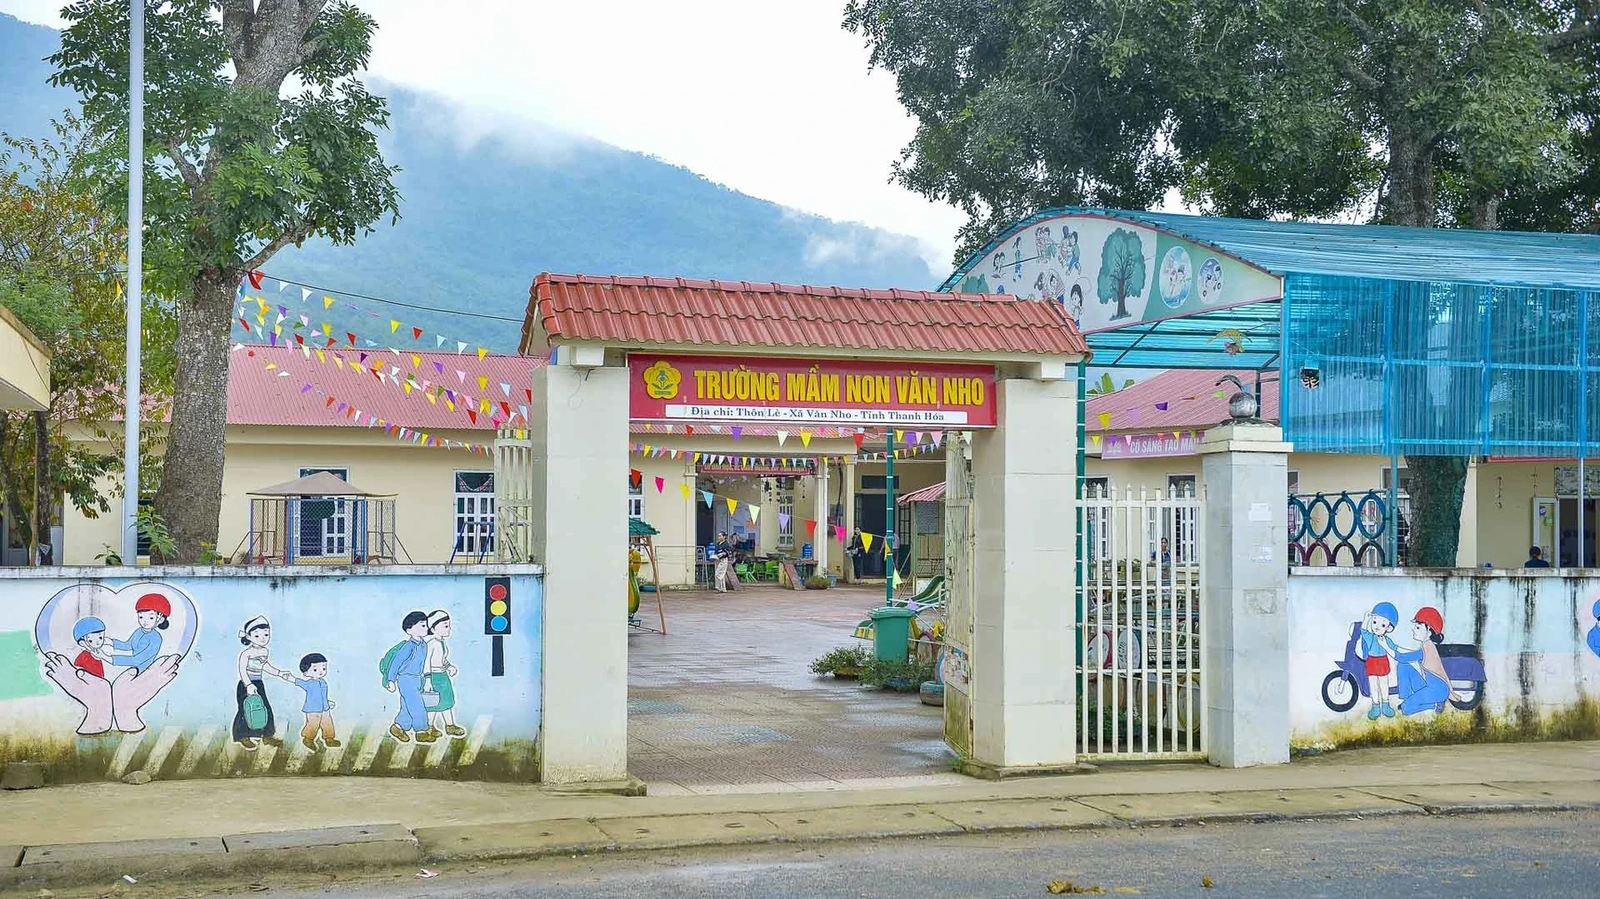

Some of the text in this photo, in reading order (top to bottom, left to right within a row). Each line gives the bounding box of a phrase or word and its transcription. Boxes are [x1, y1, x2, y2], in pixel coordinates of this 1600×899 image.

[694, 364, 985, 406] TRƯỜNG MẦM NON VĂN NHO
[691, 406, 710, 418] Địa
[736, 408, 764, 417] Thôn
[789, 409, 804, 418] Xã
[807, 409, 827, 418] Văn
[831, 411, 852, 419] Nho
[888, 411, 921, 421] Thanh
[924, 412, 945, 421] Hóa
